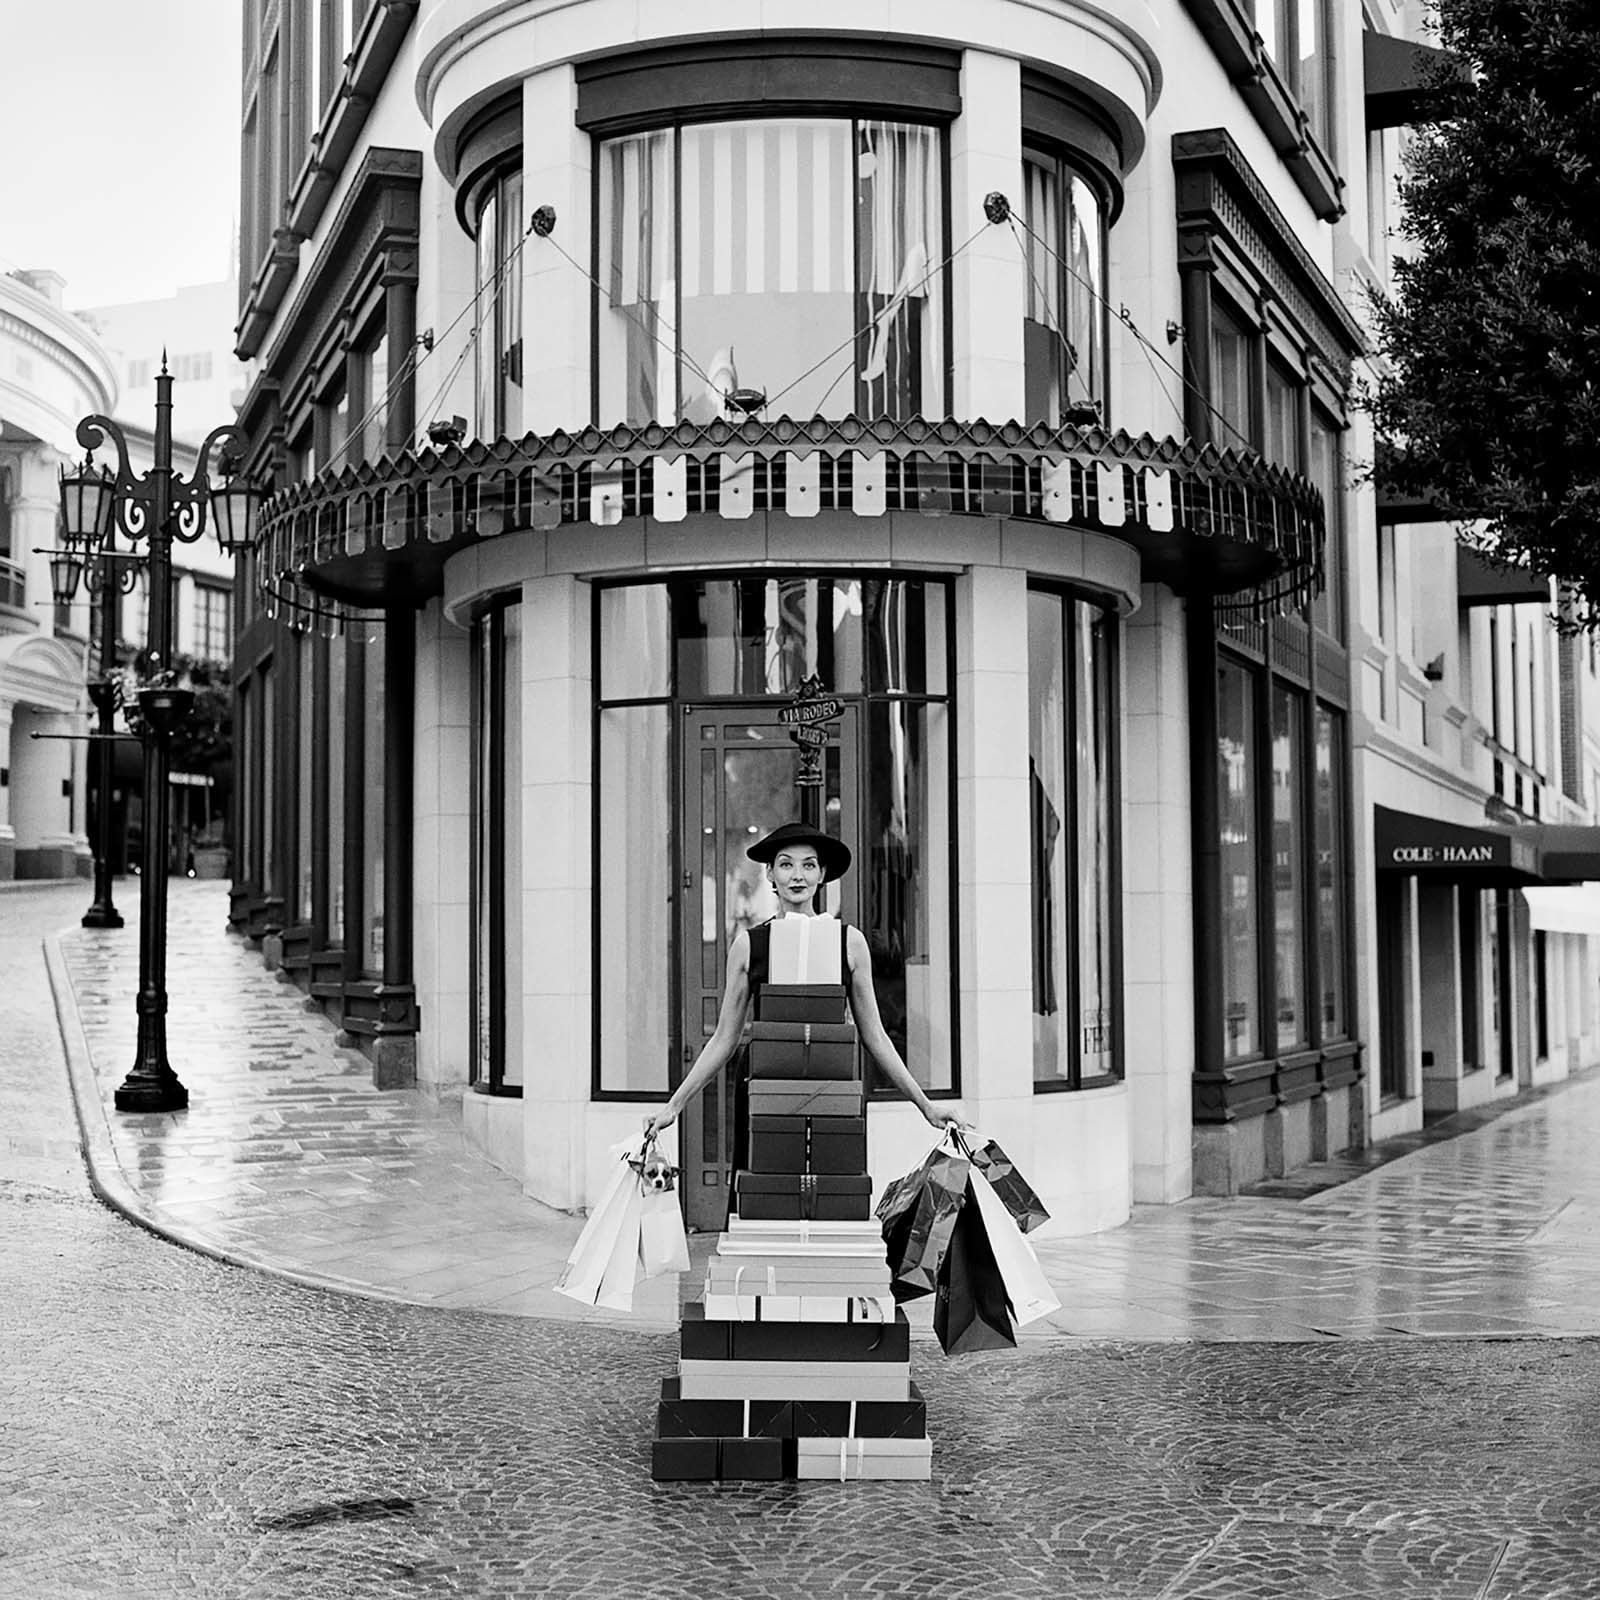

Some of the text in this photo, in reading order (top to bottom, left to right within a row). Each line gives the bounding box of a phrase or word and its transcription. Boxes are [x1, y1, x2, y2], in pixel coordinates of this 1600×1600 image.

[783, 701, 837, 722] VIA RODEO
[1392, 846, 1493, 862] COLE HAAN
